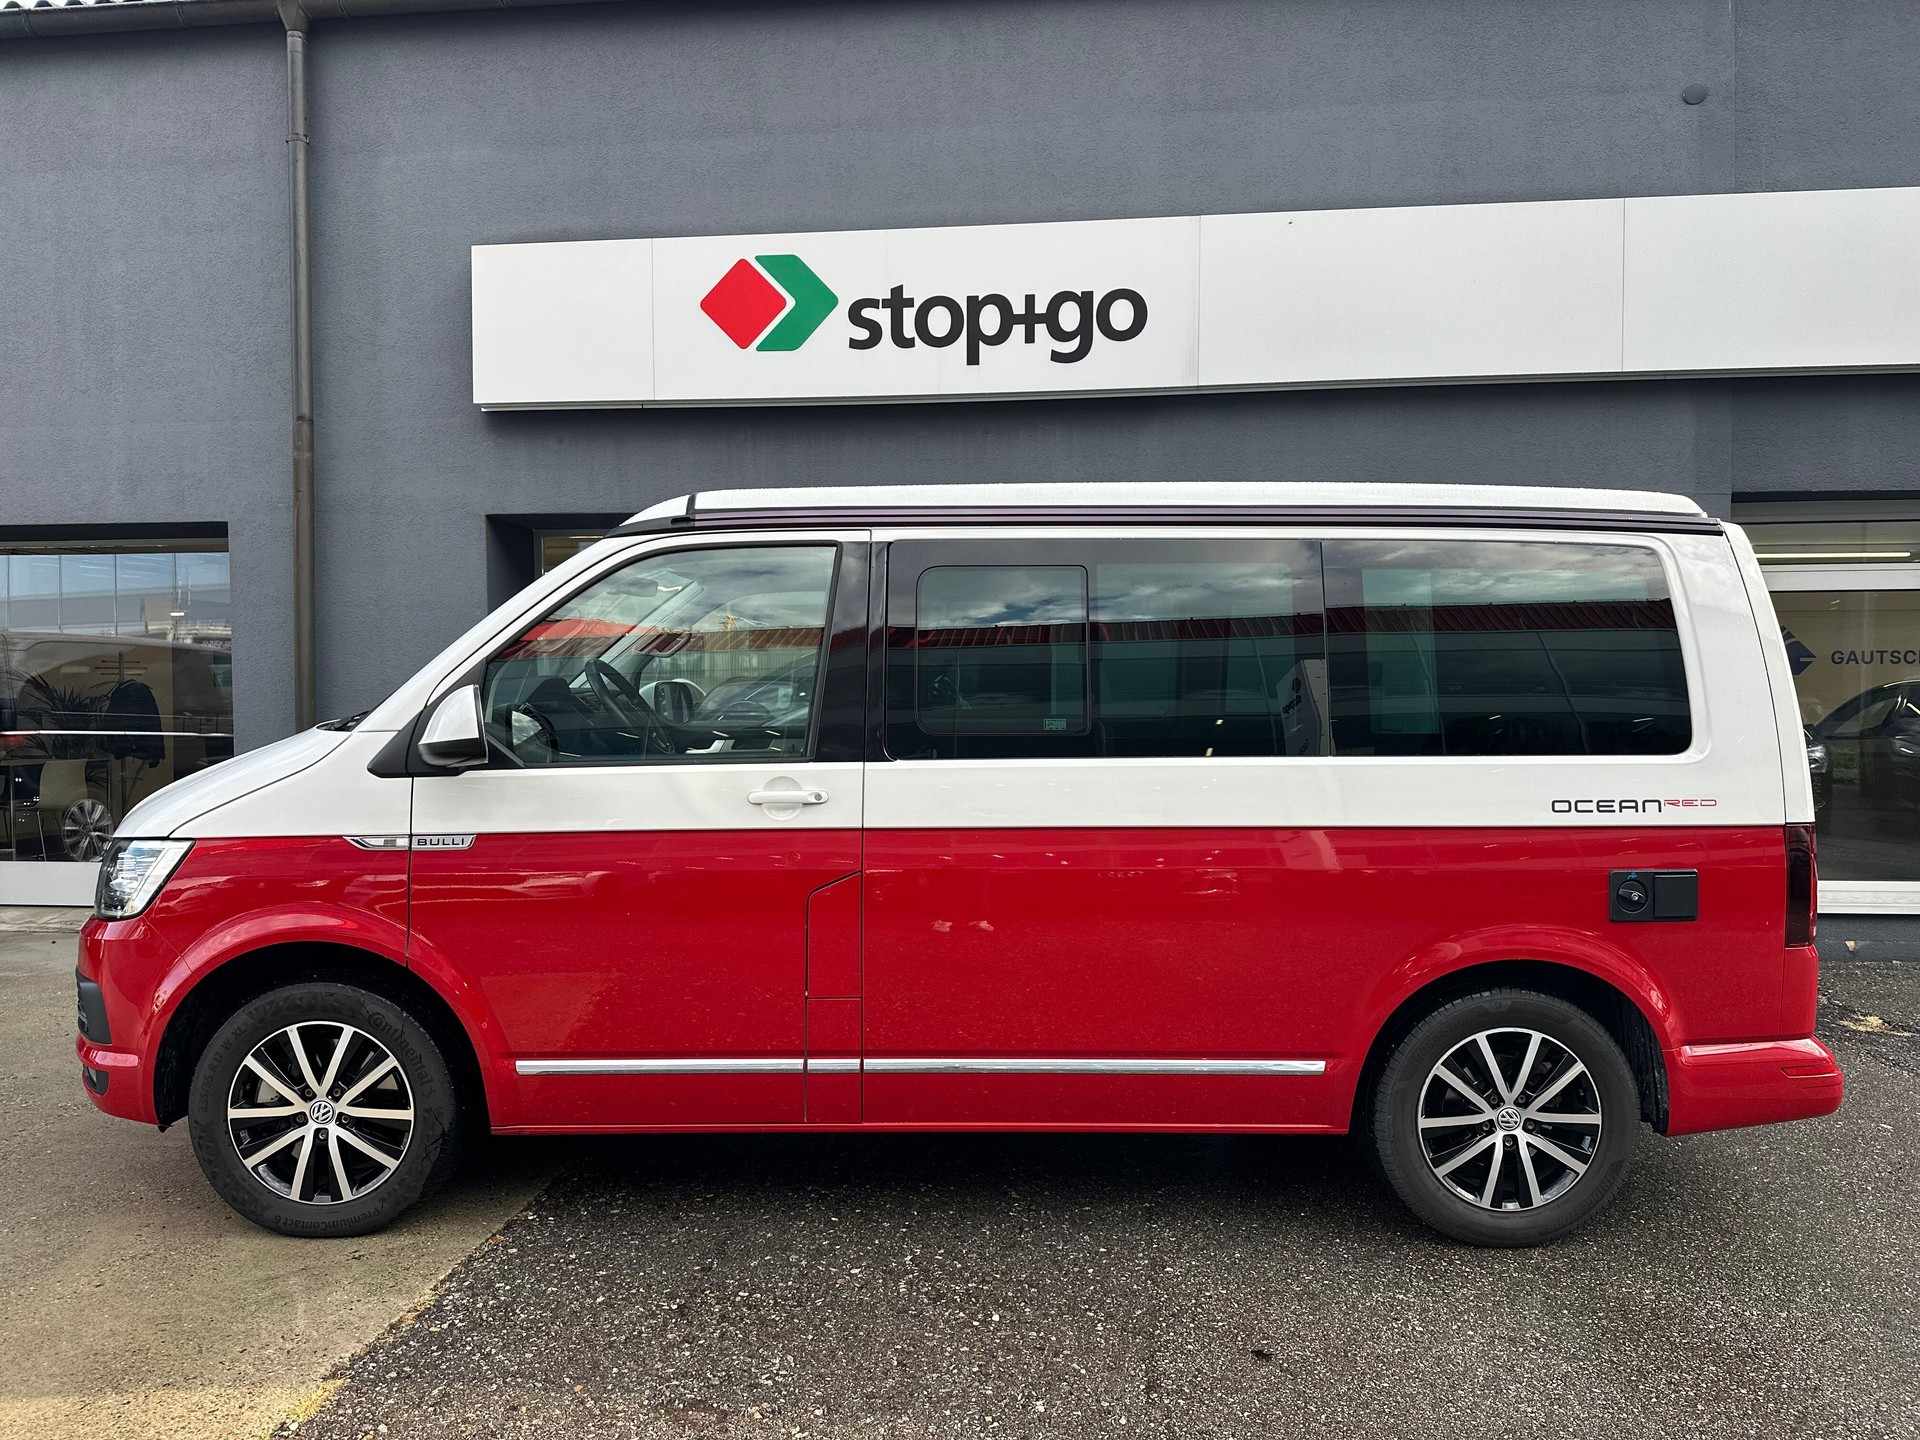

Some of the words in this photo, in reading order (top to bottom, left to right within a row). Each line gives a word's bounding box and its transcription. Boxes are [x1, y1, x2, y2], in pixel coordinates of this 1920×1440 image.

[847, 284, 1148, 366] stop+go
[1830, 649, 1920, 665] GAUTSC
[416, 837, 465, 846] BULLI
